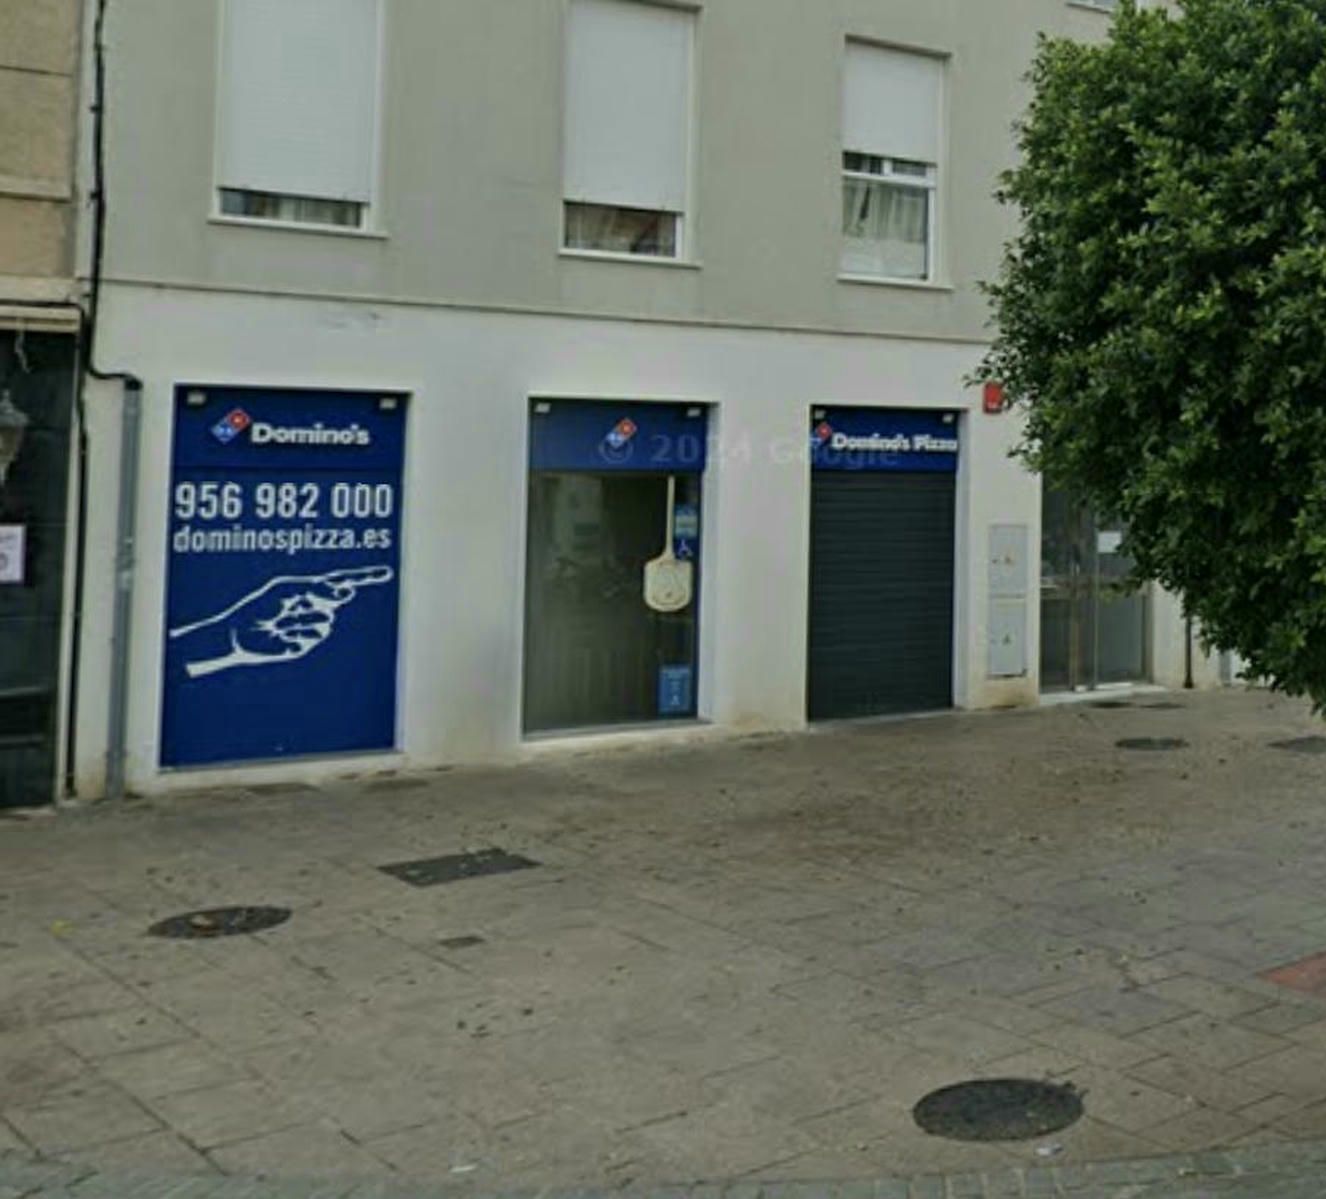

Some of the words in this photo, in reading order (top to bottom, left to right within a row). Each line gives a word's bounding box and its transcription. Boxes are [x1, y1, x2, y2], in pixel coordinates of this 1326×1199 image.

[251, 423, 370, 445] Domino's
[832, 432, 910, 451] Domino's
[913, 433, 958, 451] Pizza
[175, 481, 242, 518] 956
[255, 482, 320, 518] 982
[331, 482, 393, 518] 000
[173, 524, 392, 555] dominospizza.es
